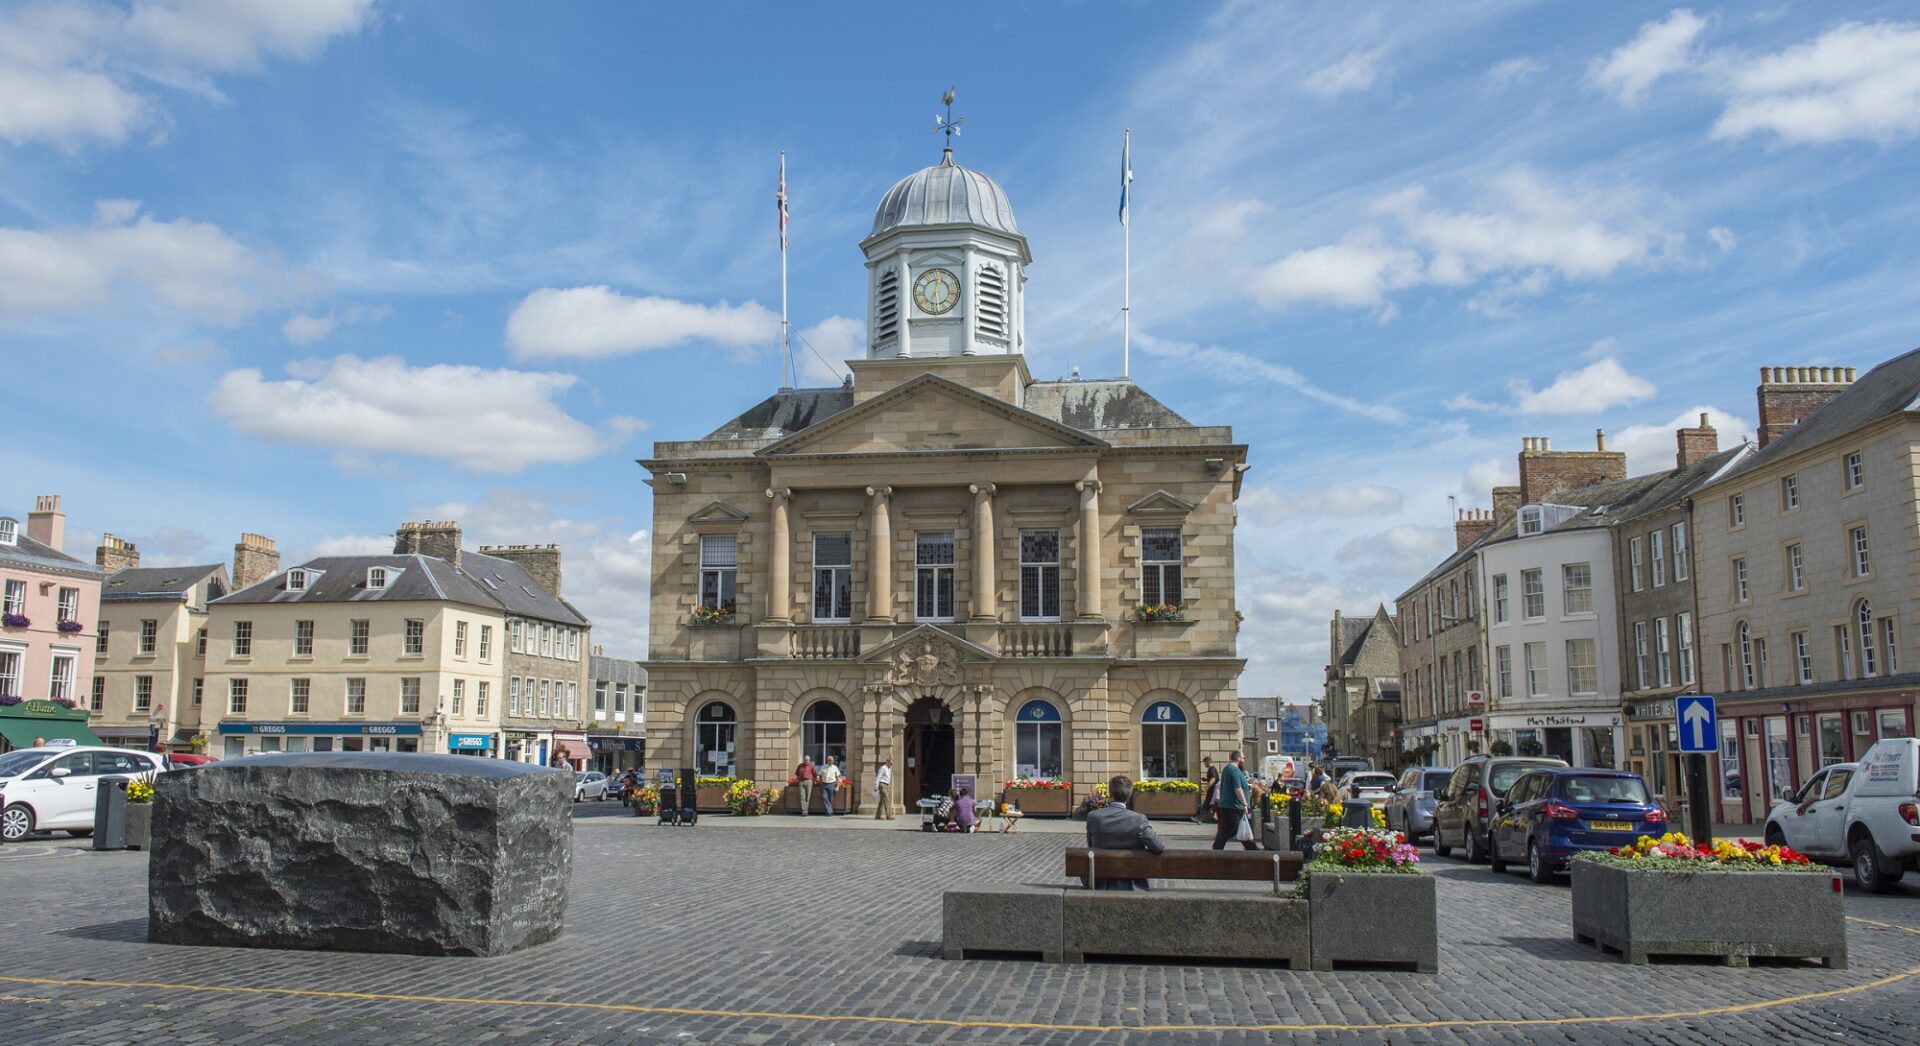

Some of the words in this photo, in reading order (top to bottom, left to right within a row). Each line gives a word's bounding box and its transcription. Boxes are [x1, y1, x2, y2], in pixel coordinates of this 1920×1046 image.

[1634, 703, 1661, 717] WHITE
[1527, 717, 1544, 726] Meg
[1546, 715, 1585, 725] Maitland
[368, 726, 396, 734] GREGGS
